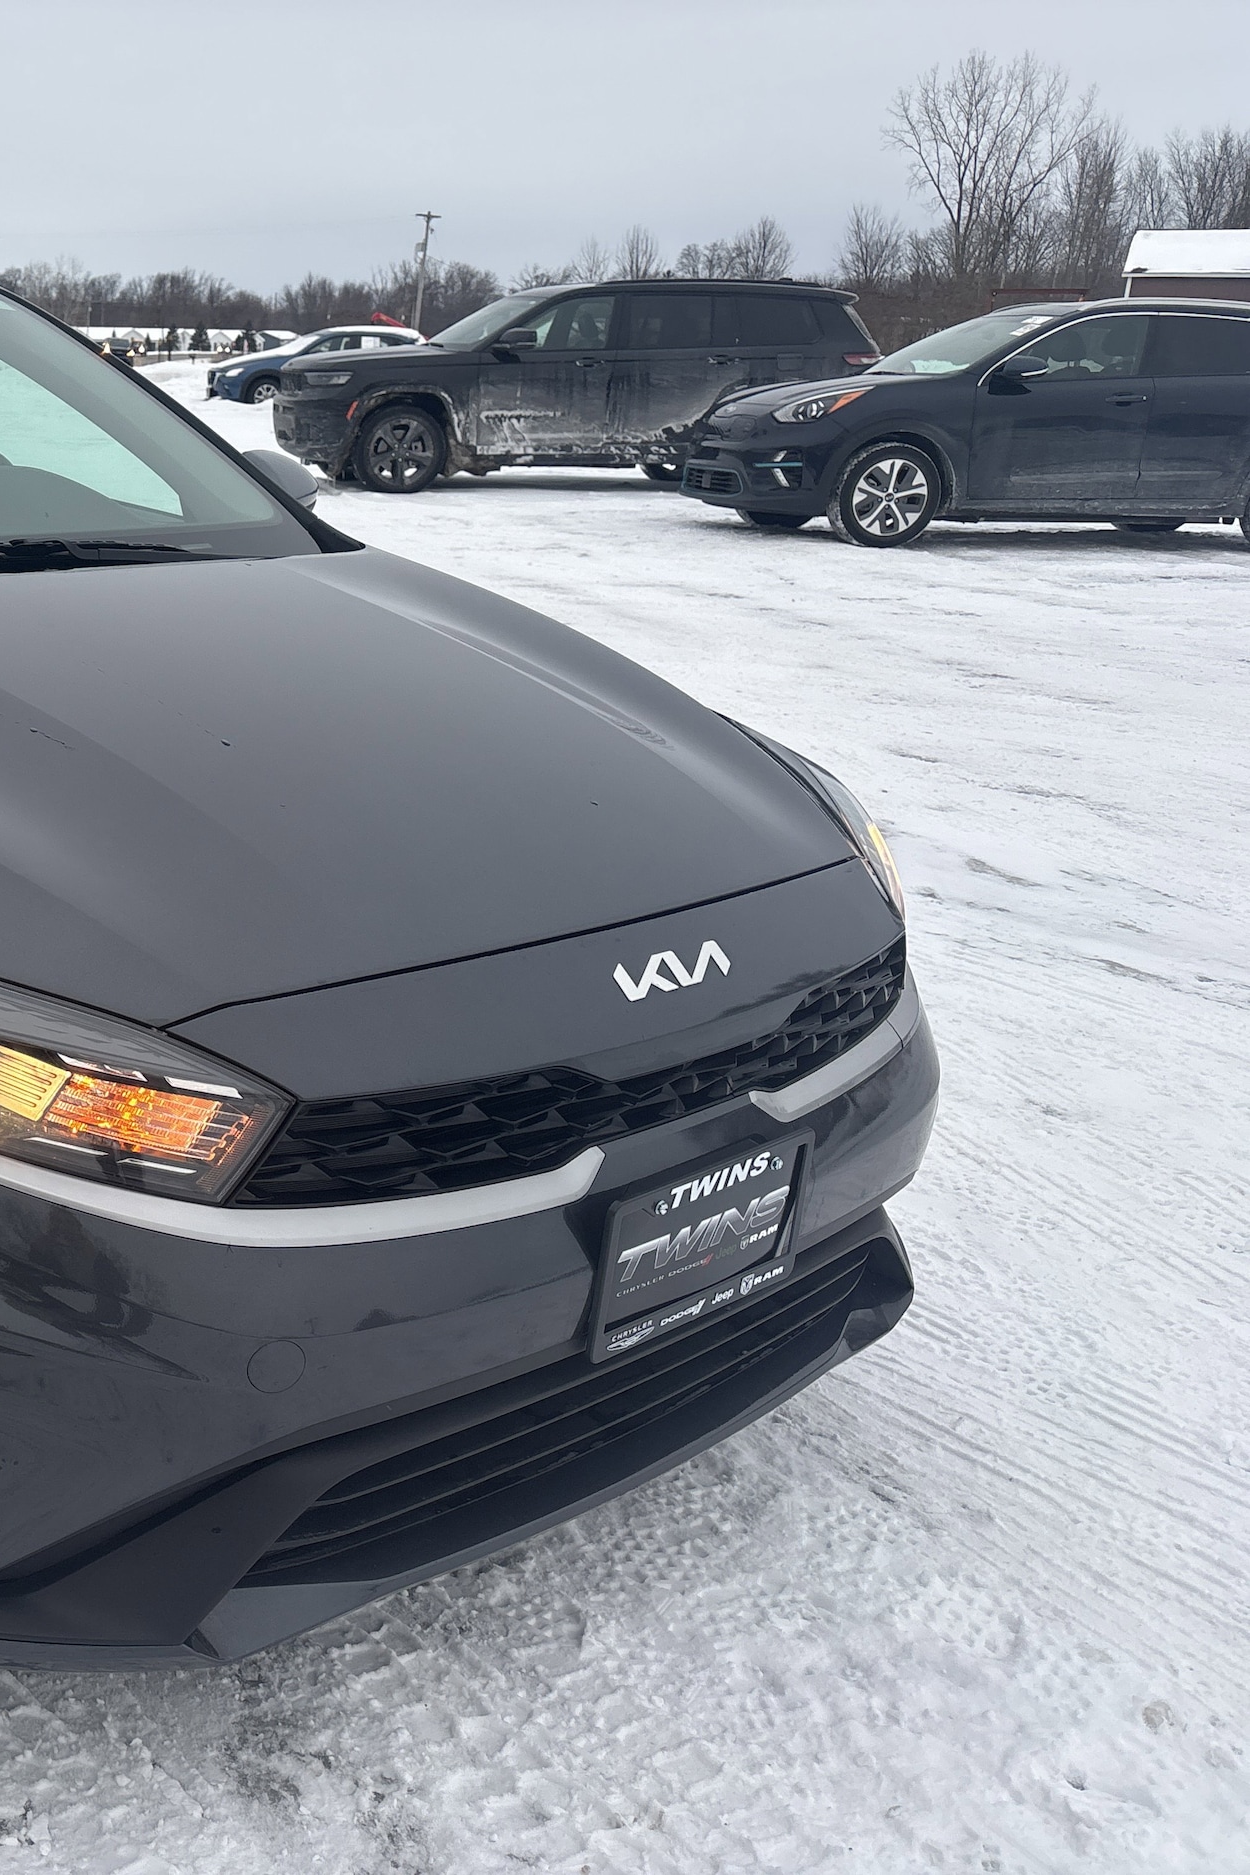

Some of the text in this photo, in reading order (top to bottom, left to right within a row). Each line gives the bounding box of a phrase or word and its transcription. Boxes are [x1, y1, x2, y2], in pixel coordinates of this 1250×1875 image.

[612, 939, 731, 1001] KIA
[670, 1151, 771, 1209] TWINS
[616, 1275, 665, 1297] CHRYSLER
[668, 1257, 708, 1277] DODGE
[749, 1223, 779, 1244] RAM
[617, 1185, 790, 1283] TWINS
[611, 1266, 784, 1342] CHRYSLER DODGE Jeep RAM
